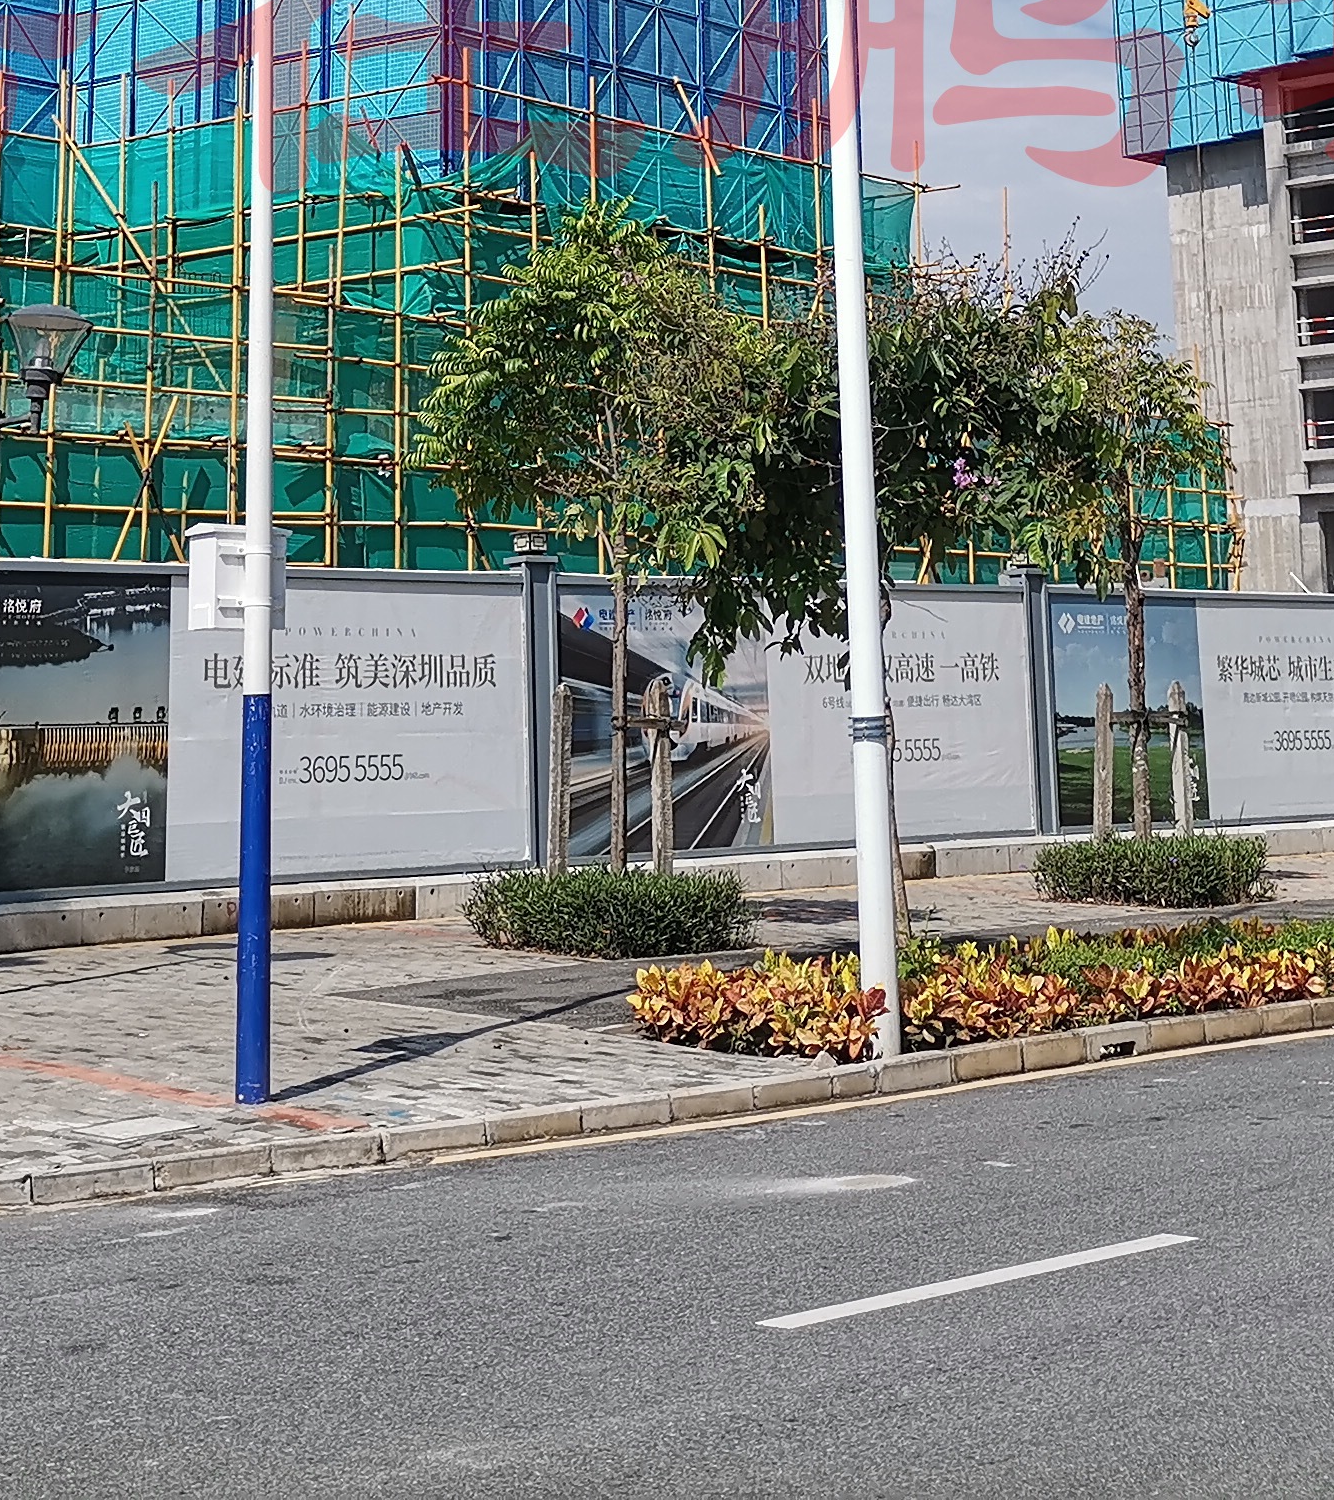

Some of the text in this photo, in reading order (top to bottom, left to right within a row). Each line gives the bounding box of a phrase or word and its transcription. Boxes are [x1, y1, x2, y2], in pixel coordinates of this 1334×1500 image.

[334, 652, 497, 690] 筑美深圳品质
[1216, 654, 1281, 683] 繁华城芯
[299, 701, 357, 719] 水环境治理
[366, 701, 411, 718] 能源建设
[420, 701, 465, 717] 地产开发
[904, 737, 942, 762] 5555
[1273, 729, 1332, 752] 3695 5555
[298, 755, 351, 784] 3695
[352, 753, 405, 783] 5555
